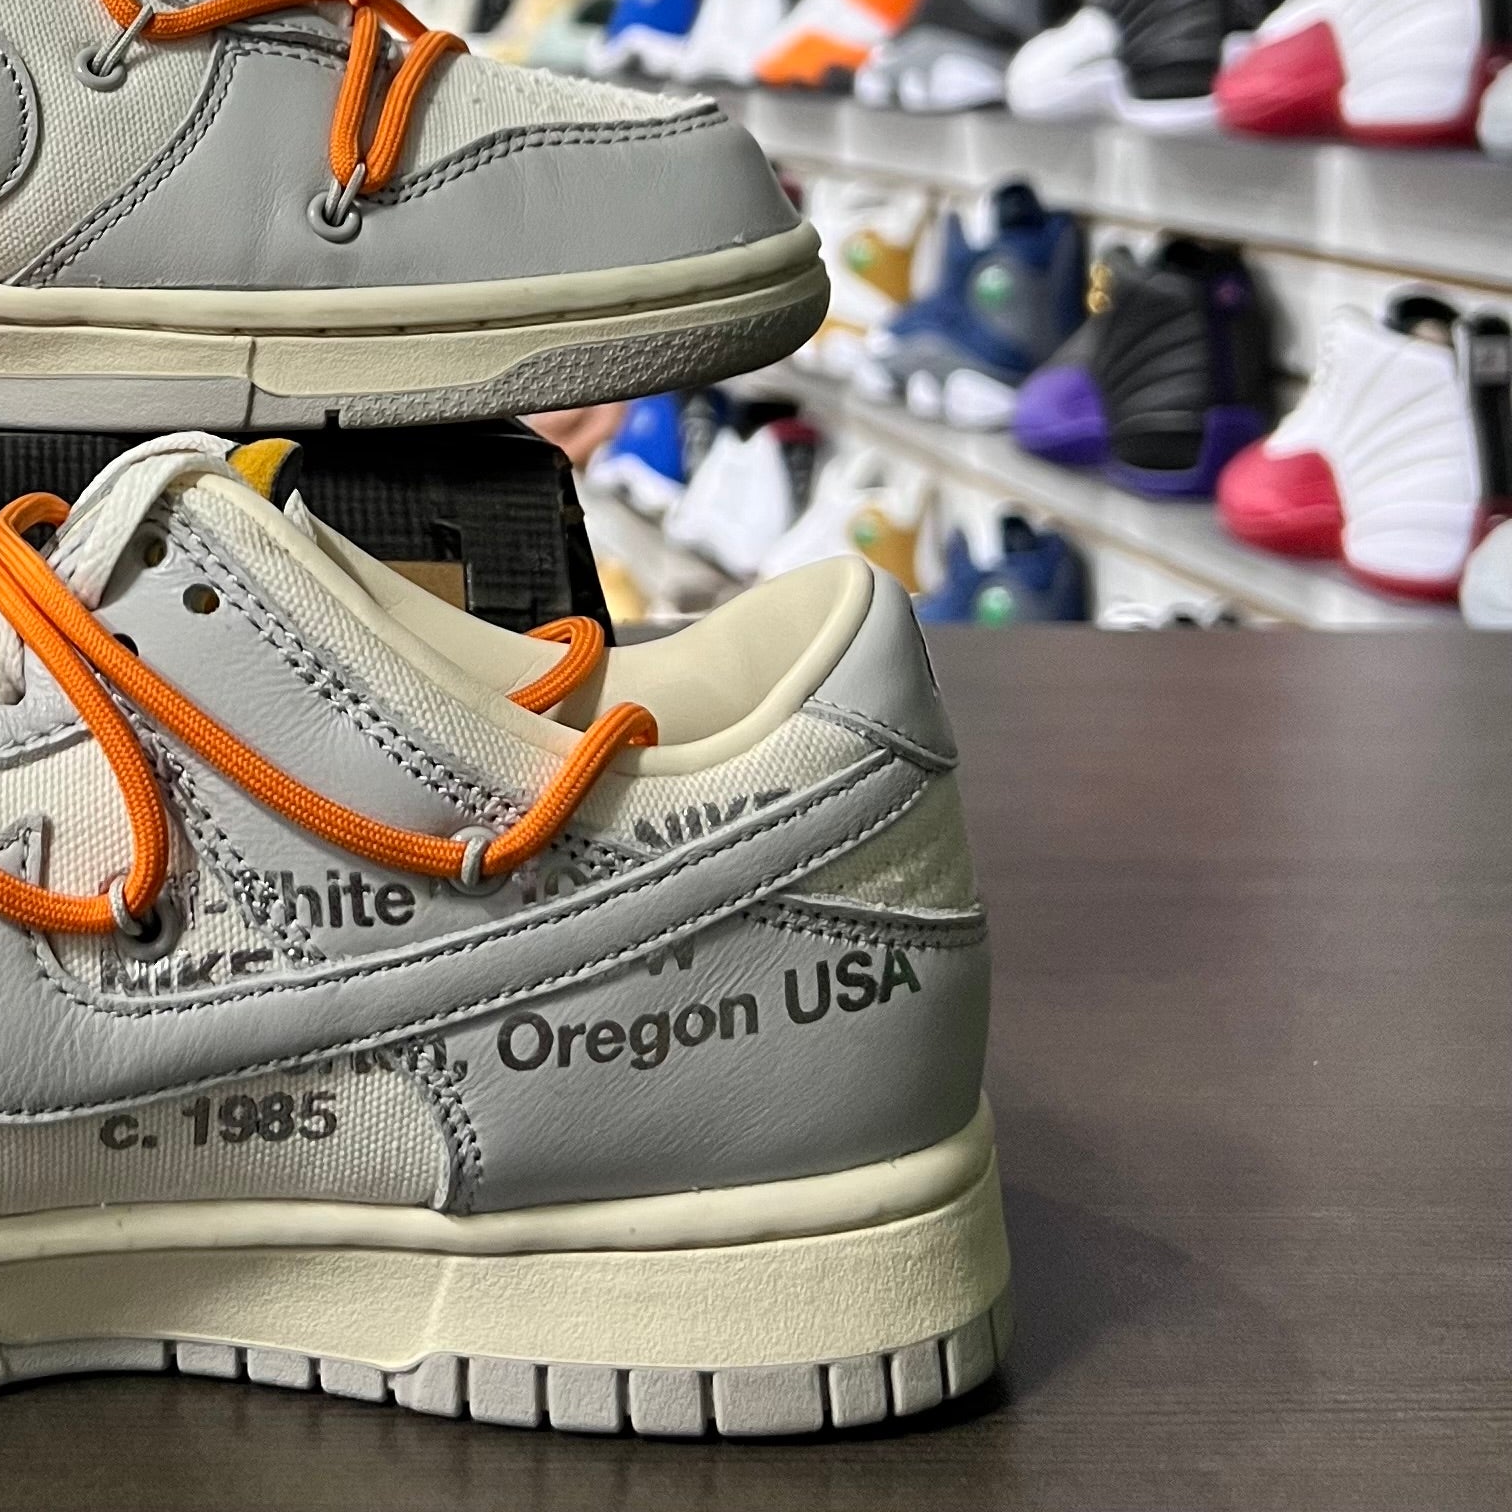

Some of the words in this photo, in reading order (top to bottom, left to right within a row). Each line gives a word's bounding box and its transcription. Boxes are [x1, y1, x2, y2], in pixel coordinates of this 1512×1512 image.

[496, 991, 759, 1072] Oregon
[784, 948, 922, 1025] USA
[99, 1113, 158, 1150] c.
[182, 1090, 338, 1147] 1985
